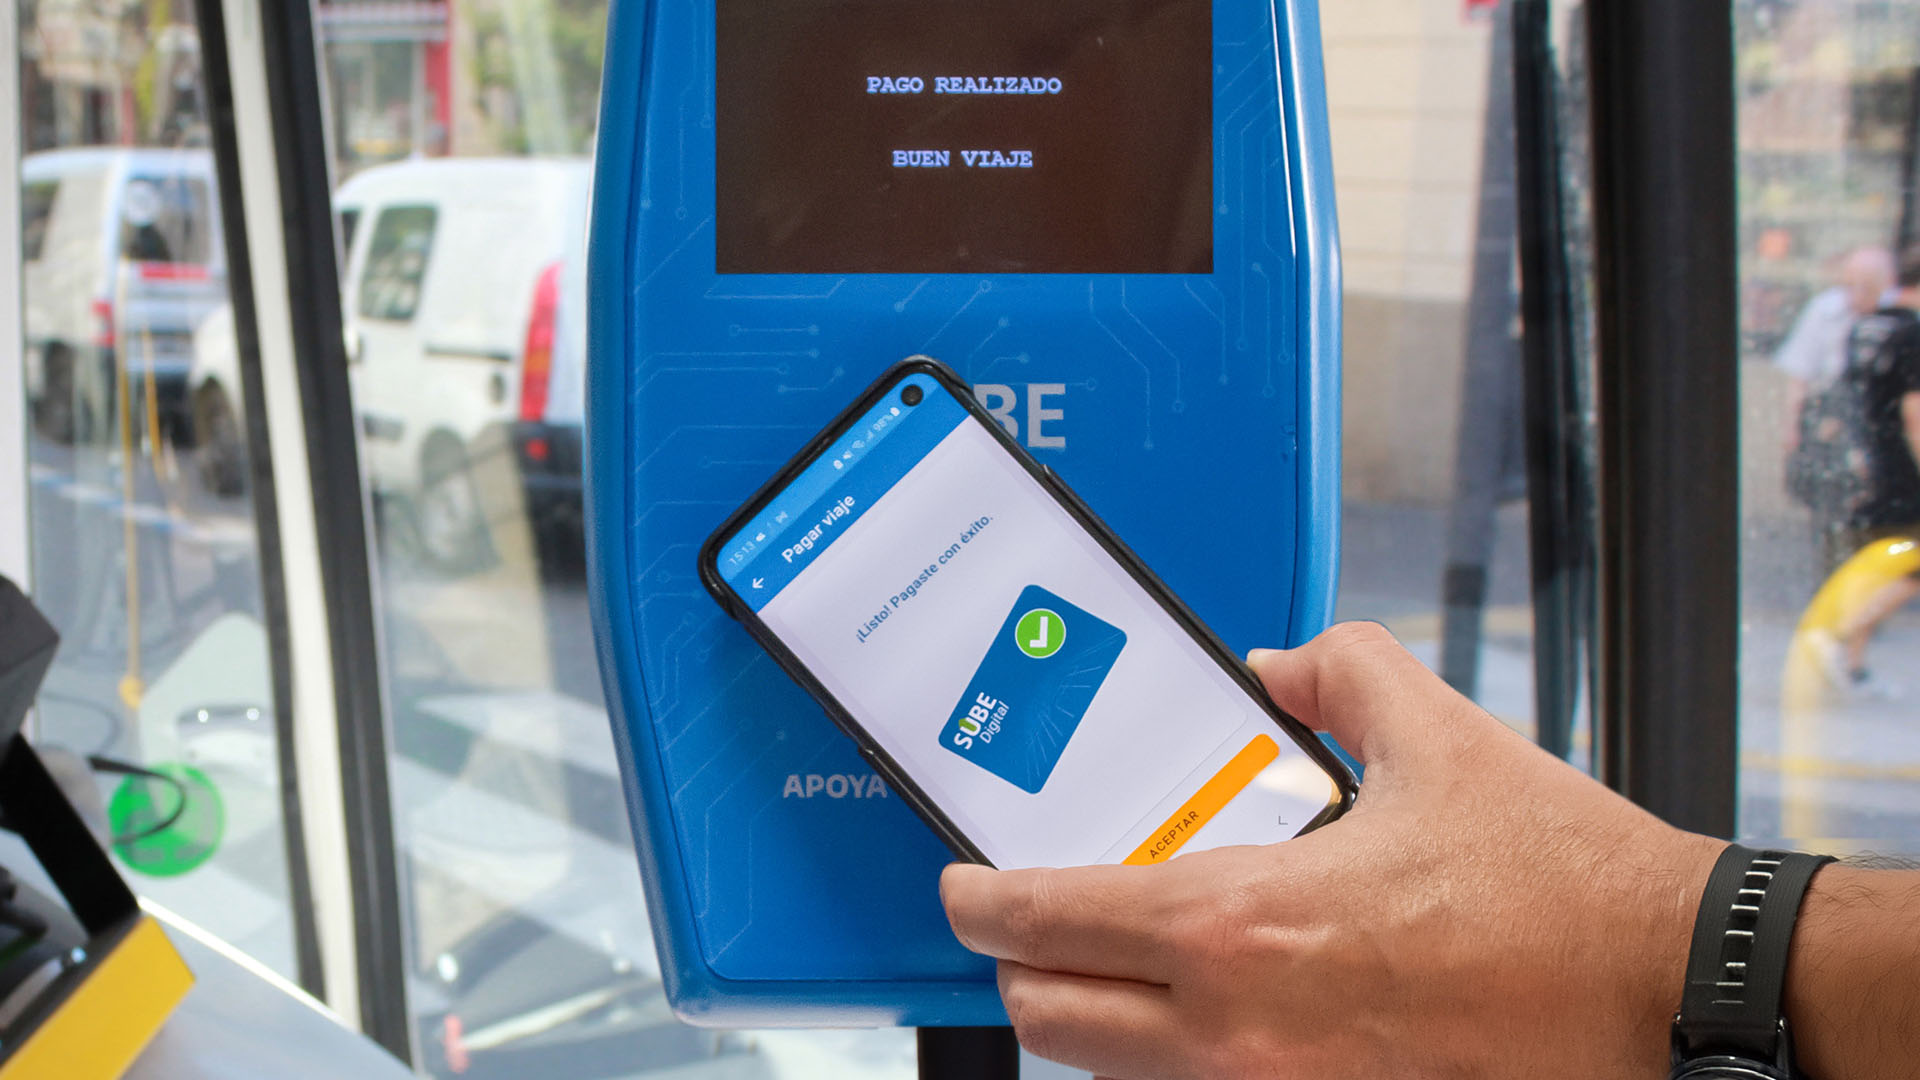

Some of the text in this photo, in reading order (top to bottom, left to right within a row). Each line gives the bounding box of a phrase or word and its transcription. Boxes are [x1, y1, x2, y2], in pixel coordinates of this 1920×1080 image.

[866, 76, 1063, 95] PAGO REALIZADO
[892, 150, 1034, 168] BUEN VIAJE
[973, 383, 1066, 448] BE
[781, 495, 855, 563] Pagar viaje
[856, 515, 994, 643] ¡Listo! Pagaste con éxito.
[953, 691, 998, 750] SUBE
[979, 700, 1010, 744] Digital
[783, 773, 888, 799] APOYA
[1149, 810, 1200, 860] ACEPTAR
